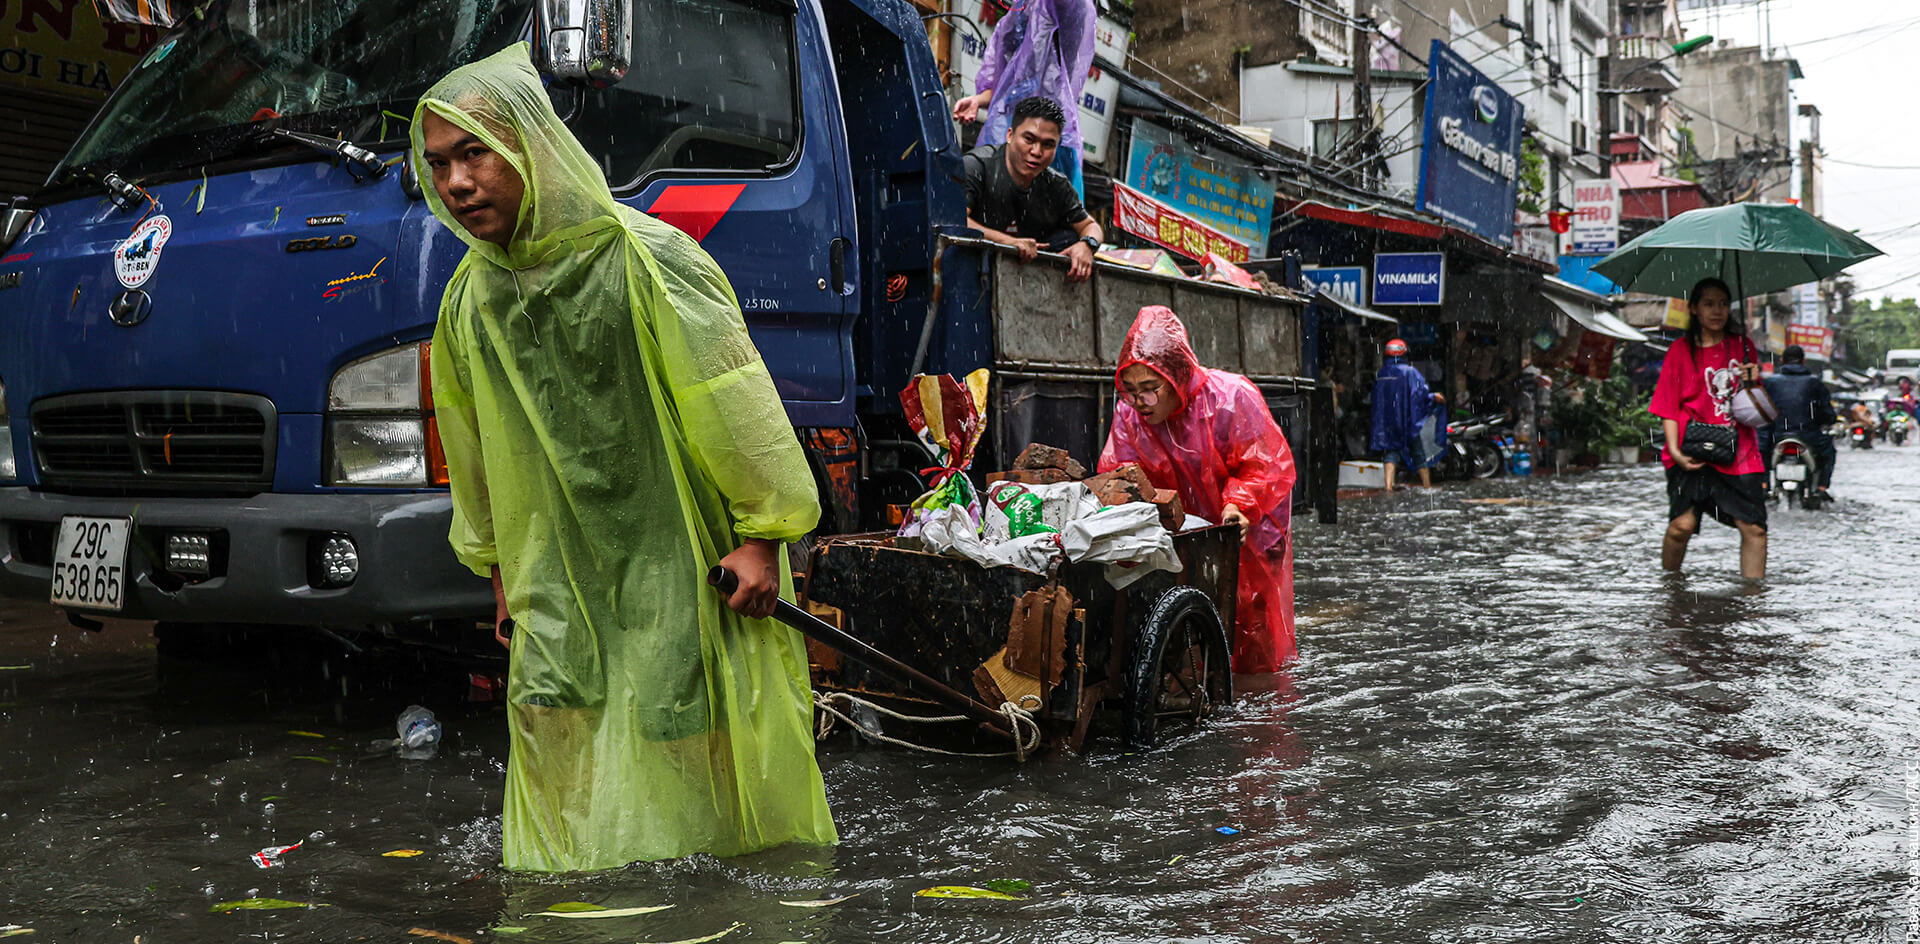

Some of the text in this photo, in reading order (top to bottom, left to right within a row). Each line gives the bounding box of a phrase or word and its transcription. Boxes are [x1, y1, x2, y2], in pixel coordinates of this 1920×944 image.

[1576, 184, 1613, 202] NHÀ
[1577, 206, 1611, 224] TRỌ
[1378, 273, 1438, 284] VINAMILK
[760, 299, 780, 309] TON
[71, 521, 112, 560] 29C
[53, 562, 121, 605] 538.65
